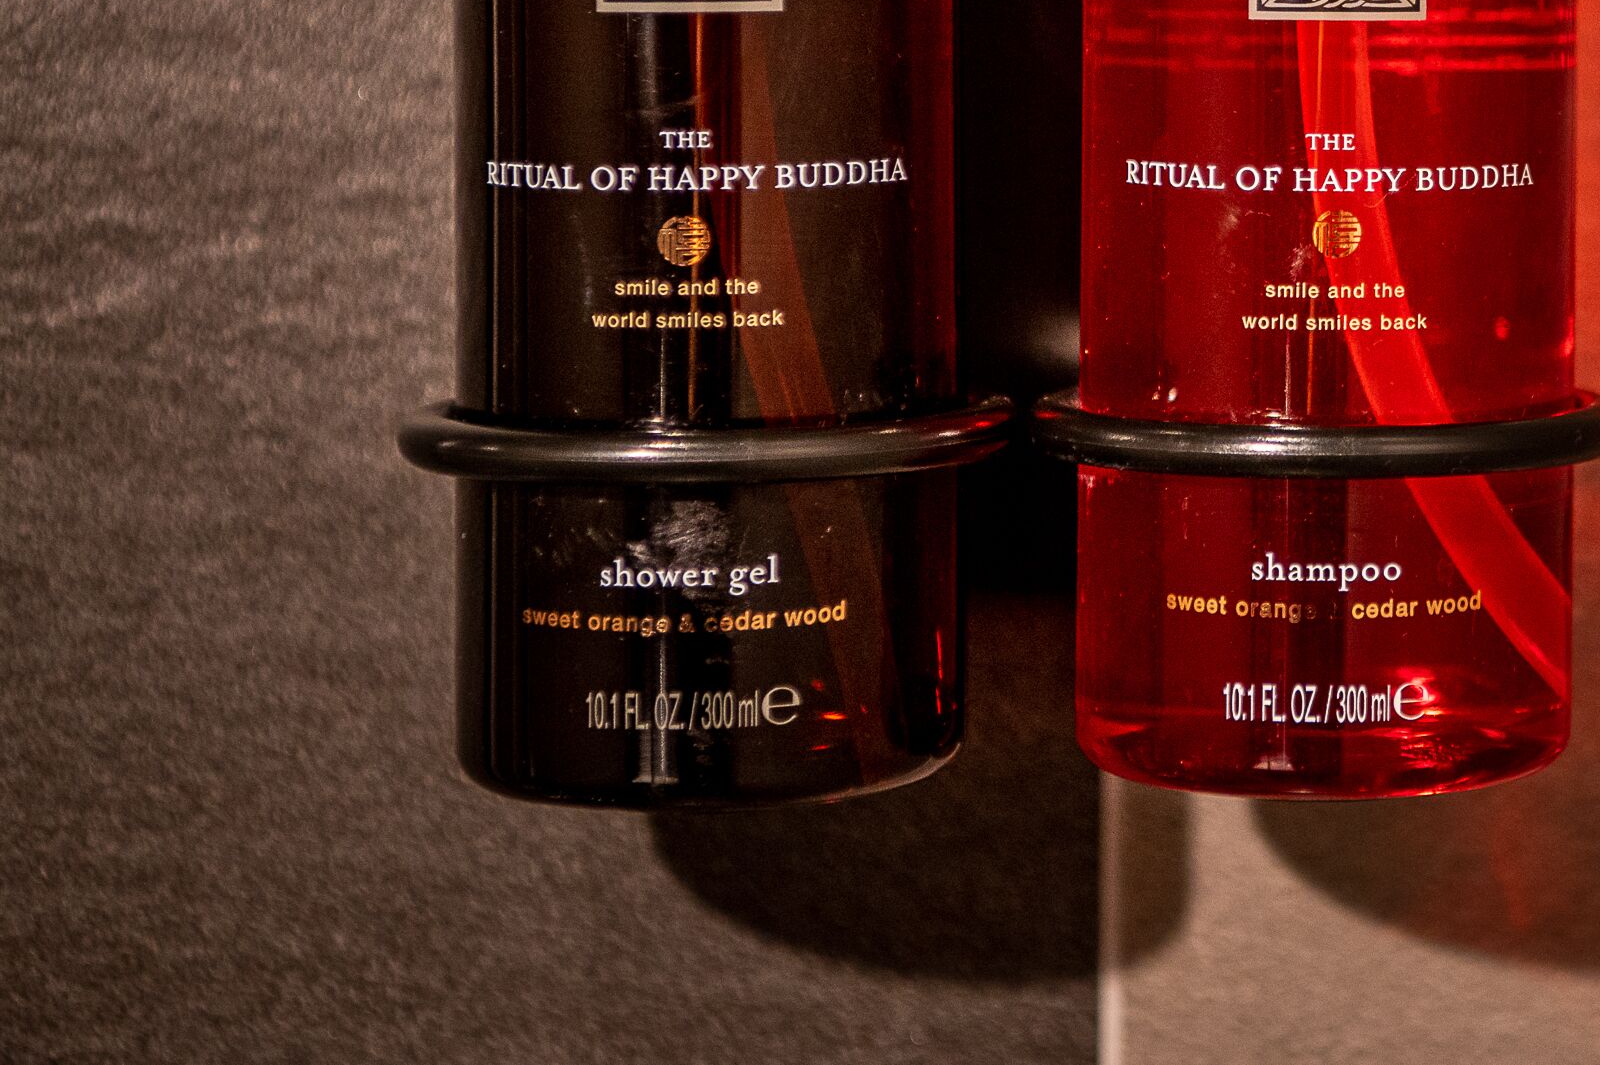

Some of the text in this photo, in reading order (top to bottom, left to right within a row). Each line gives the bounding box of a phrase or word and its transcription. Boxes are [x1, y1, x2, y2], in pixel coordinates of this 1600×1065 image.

[659, 131, 711, 149] THE
[1305, 133, 1355, 151] THE
[487, 158, 908, 191] RITUAL OF HAPPY BUDDHA
[1126, 159, 1534, 193] RITUAL OF HAPPY BUDDHA
[614, 278, 759, 296] smile and the
[1265, 282, 1405, 299] smile and the
[592, 310, 784, 328] world smiles back
[1242, 314, 1427, 331] world smiles back
[600, 553, 779, 596] shower gel
[1251, 552, 1402, 592] shampoo
[522, 607, 581, 629] sweet
[587, 613, 671, 637] orange
[705, 610, 777, 632] cedar
[784, 600, 847, 627] wood
[1166, 593, 1227, 615] sweet
[1352, 598, 1418, 620] cedar
[1426, 590, 1482, 615] wood
[585, 691, 617, 729] 10.1
[624, 693, 649, 730] FL.
[654, 692, 685, 730] OZ.
[701, 691, 734, 729] 300
[1223, 683, 1255, 721] 10.1
[1261, 683, 1287, 722] FL.
[1291, 684, 1321, 723] OZ.
[1336, 685, 1368, 723] 300
